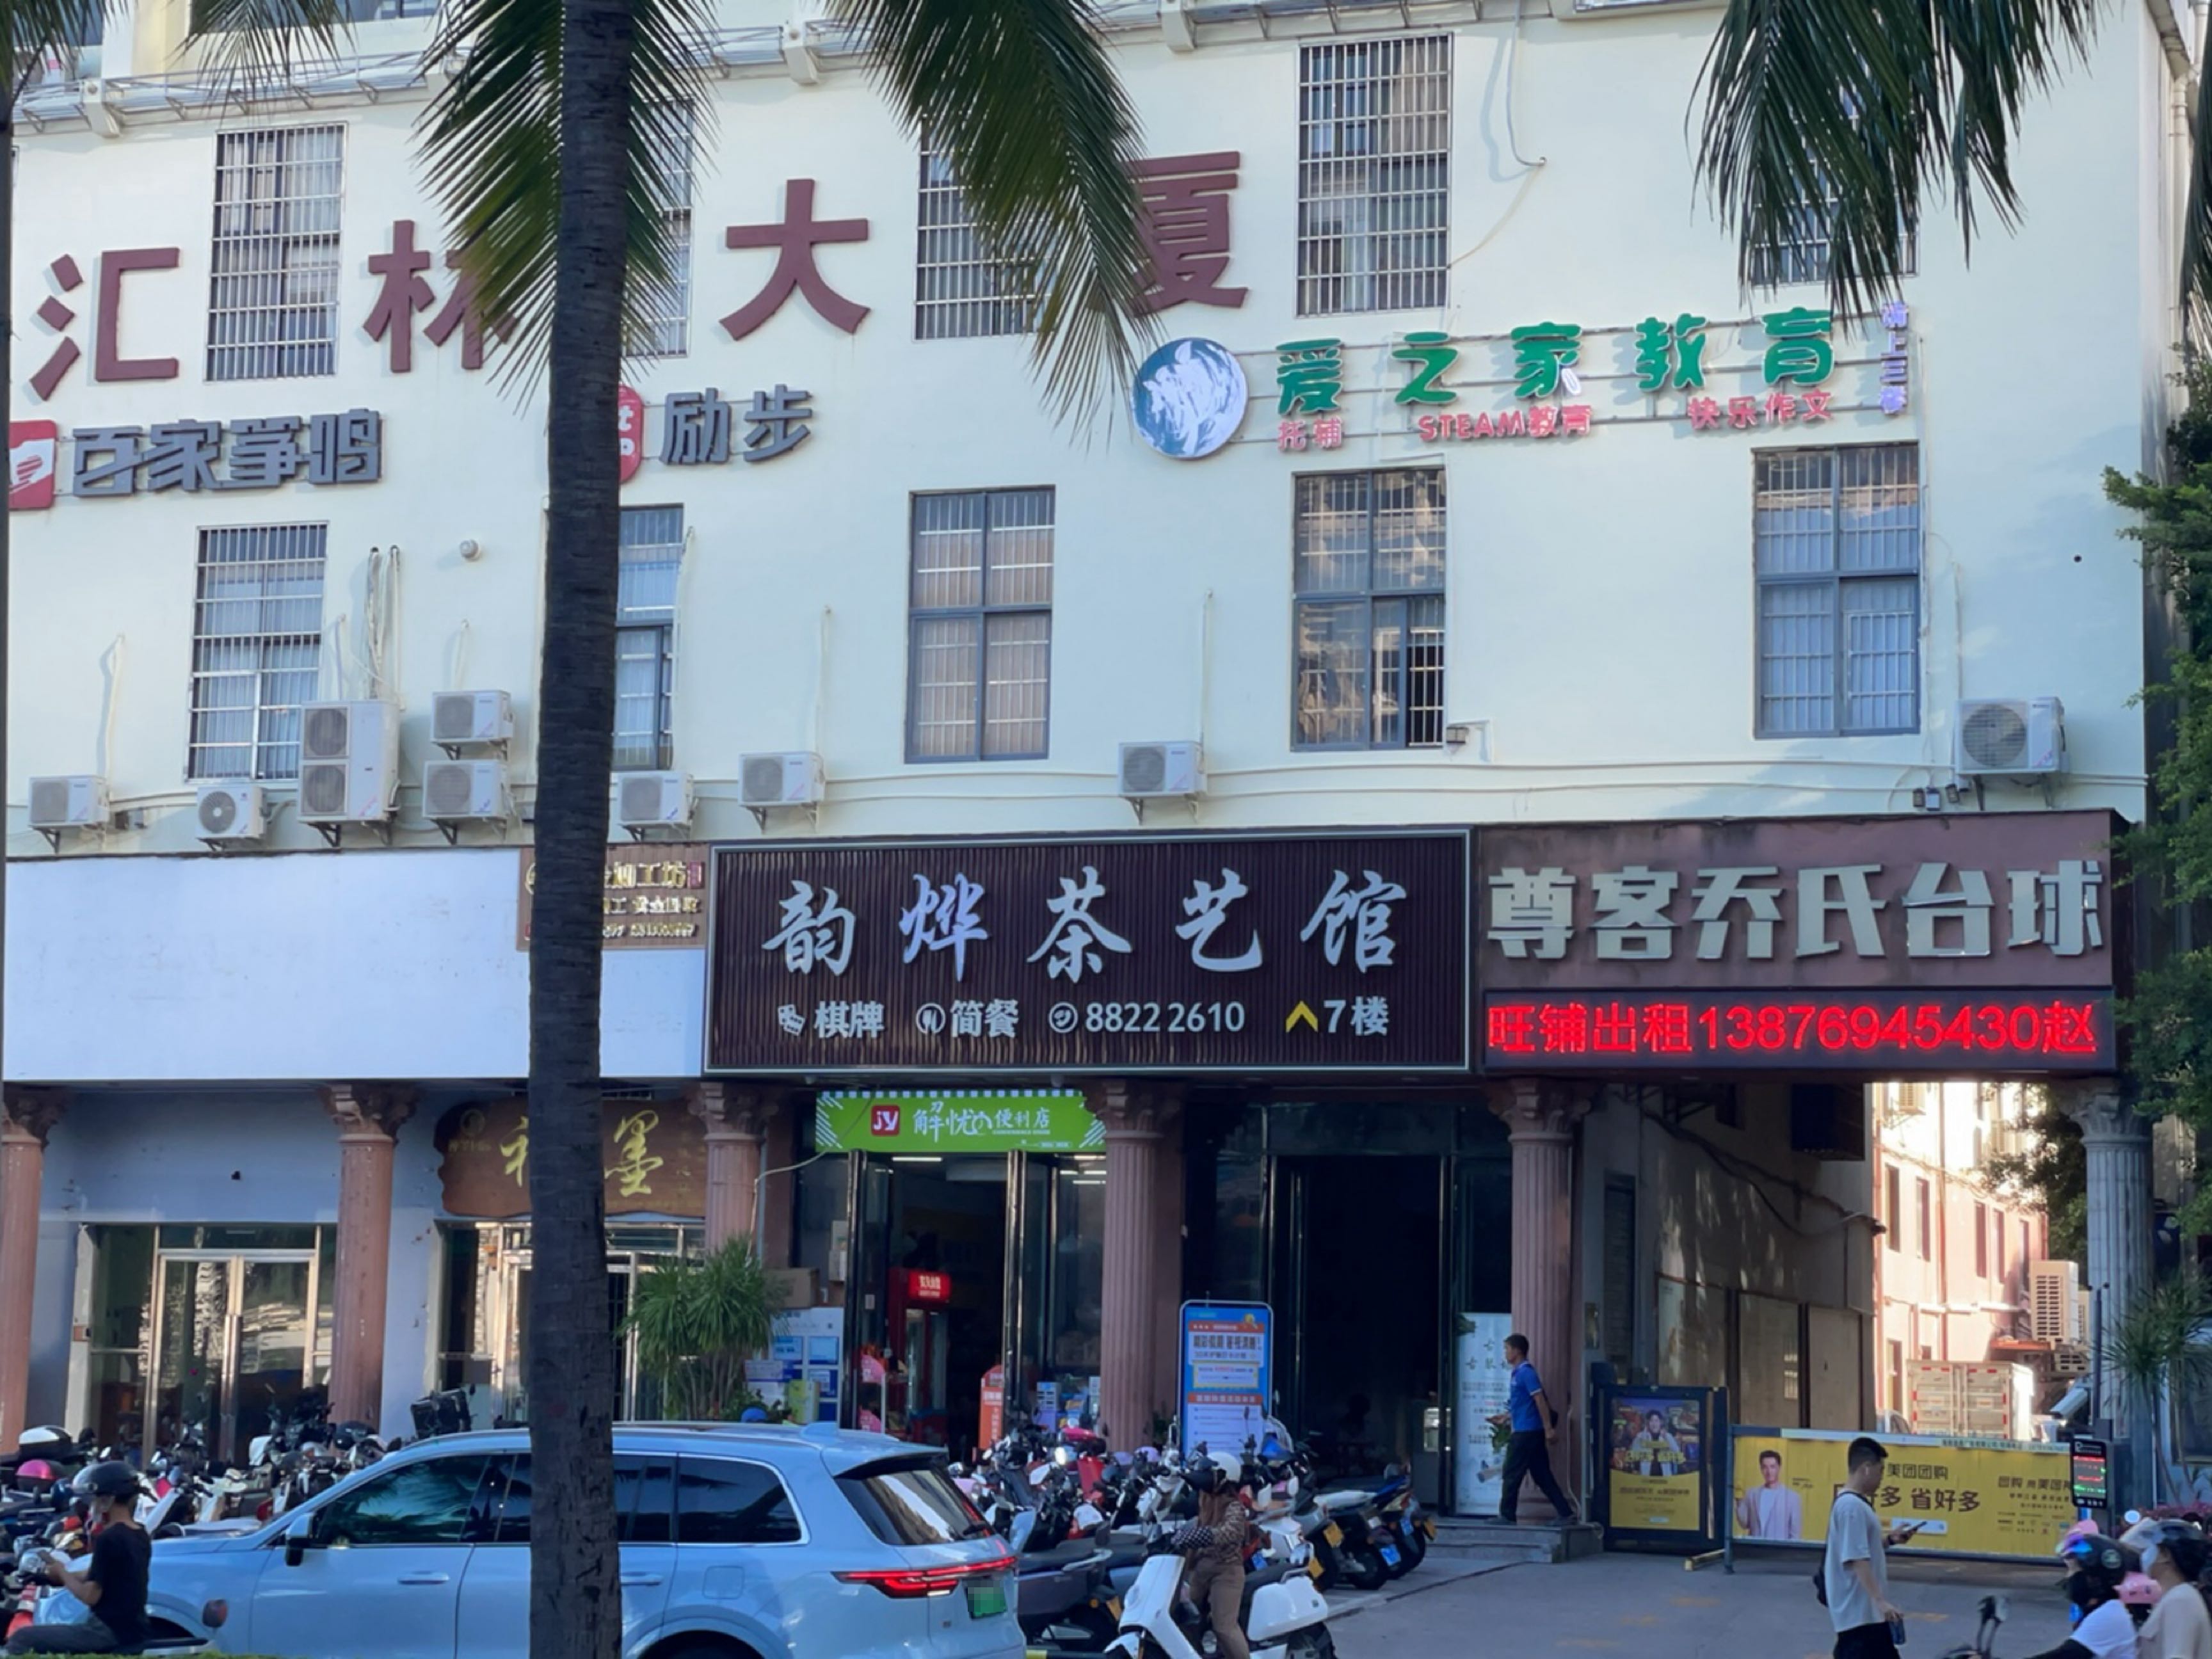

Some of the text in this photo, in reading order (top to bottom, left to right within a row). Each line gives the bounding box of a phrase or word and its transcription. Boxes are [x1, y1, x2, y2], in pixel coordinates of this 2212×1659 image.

[29, 150, 1248, 400] 汇林大厦
[1276, 306, 1836, 415] 爱之家教育
[659, 383, 813, 465] 励步
[1417, 403, 1592, 443] STEAM教育
[1687, 389, 1834, 431] 快乐作文
[762, 865, 1407, 984] 韵烨茶艺馆
[1486, 860, 2105, 960] 尊客乔氏台球
[813, 1000, 885, 1039] 棋牌
[950, 998, 1019, 1038] 简餐
[1324, 996, 1390, 1036] 7楼
[1488, 1000, 2097, 1055] 旺铺出租13876945430赵
[1911, 1487, 1981, 1512] 省好多
